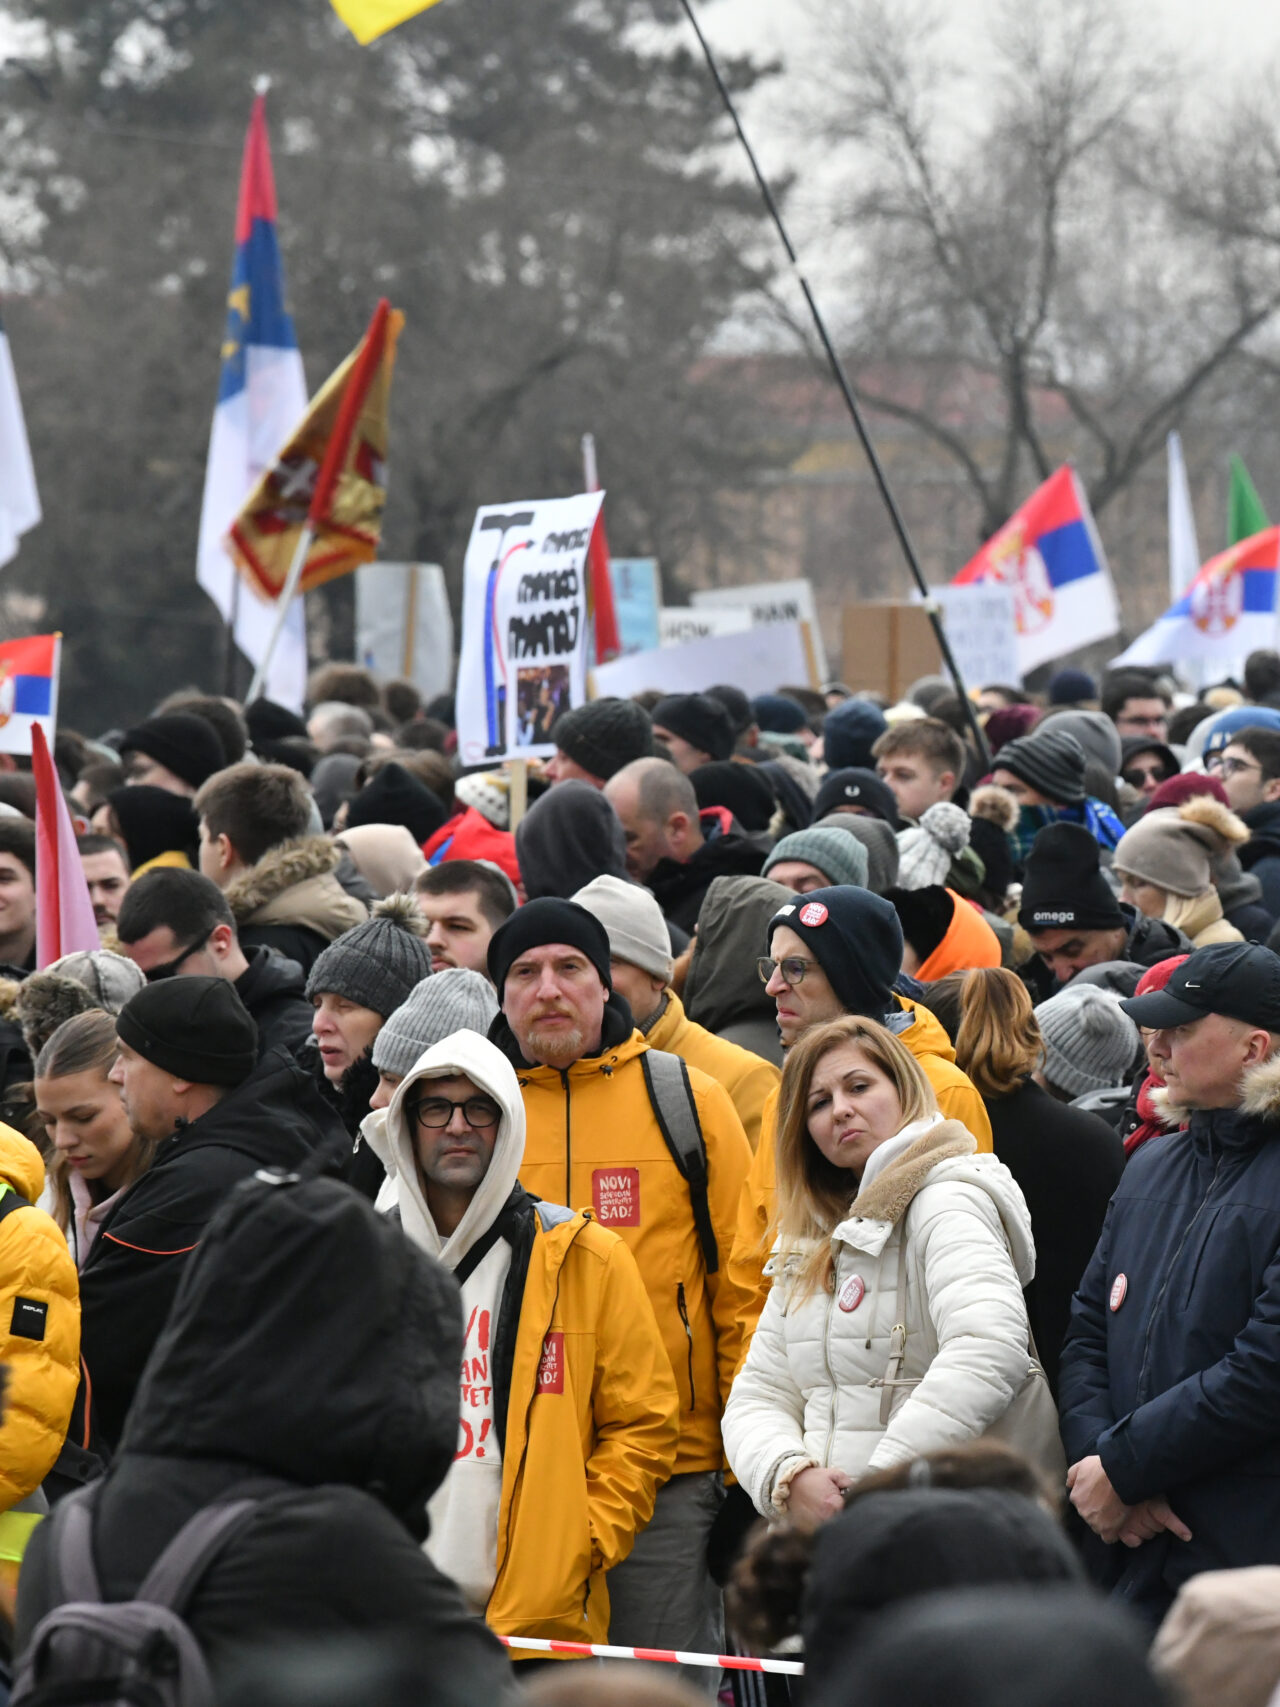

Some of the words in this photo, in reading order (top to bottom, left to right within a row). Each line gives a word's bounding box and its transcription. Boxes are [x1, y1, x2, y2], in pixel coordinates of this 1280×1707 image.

[1033, 911, 1075, 923] omega
[599, 1175, 631, 1191] NOVI
[600, 1205, 633, 1220] SAD!
